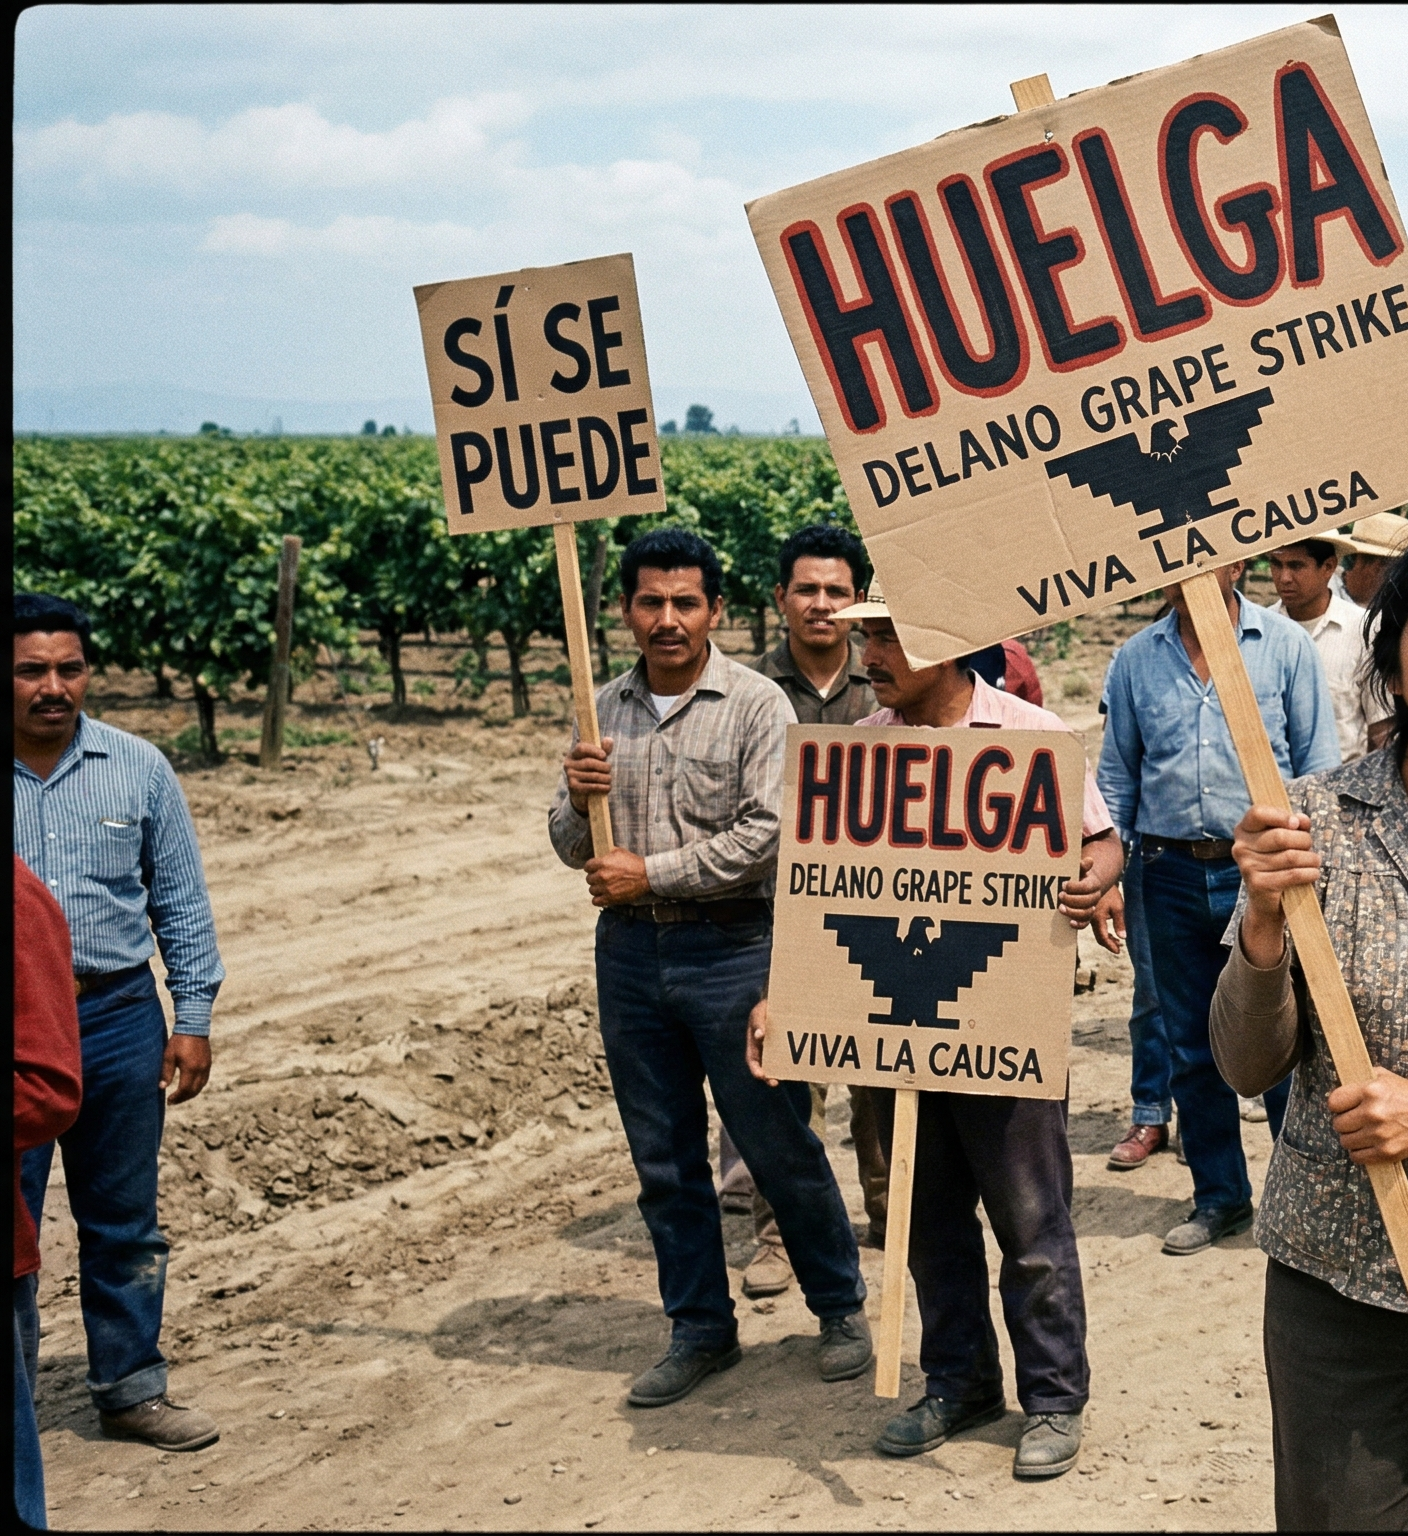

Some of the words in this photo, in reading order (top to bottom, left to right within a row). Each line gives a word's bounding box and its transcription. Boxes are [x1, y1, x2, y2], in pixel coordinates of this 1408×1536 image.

[780, 62, 1404, 434] HUELGA
[444, 285, 520, 408] SÍ
[543, 295, 632, 394] SE
[450, 407, 658, 515] PUEDE
[862, 404, 1061, 508] DELANO
[1081, 344, 1236, 433] GRAPE
[1016, 555, 1136, 616] VIVA
[1153, 527, 1218, 573] LA
[1231, 470, 1379, 544] CAUSA
[795, 741, 1069, 858] HUELGA
[789, 862, 884, 900] DELANO
[892, 867, 973, 905] GRAPE
[787, 1030, 861, 1070] VIVA
[875, 1037, 916, 1074] LA
[928, 1042, 1043, 1084] CAUSA
